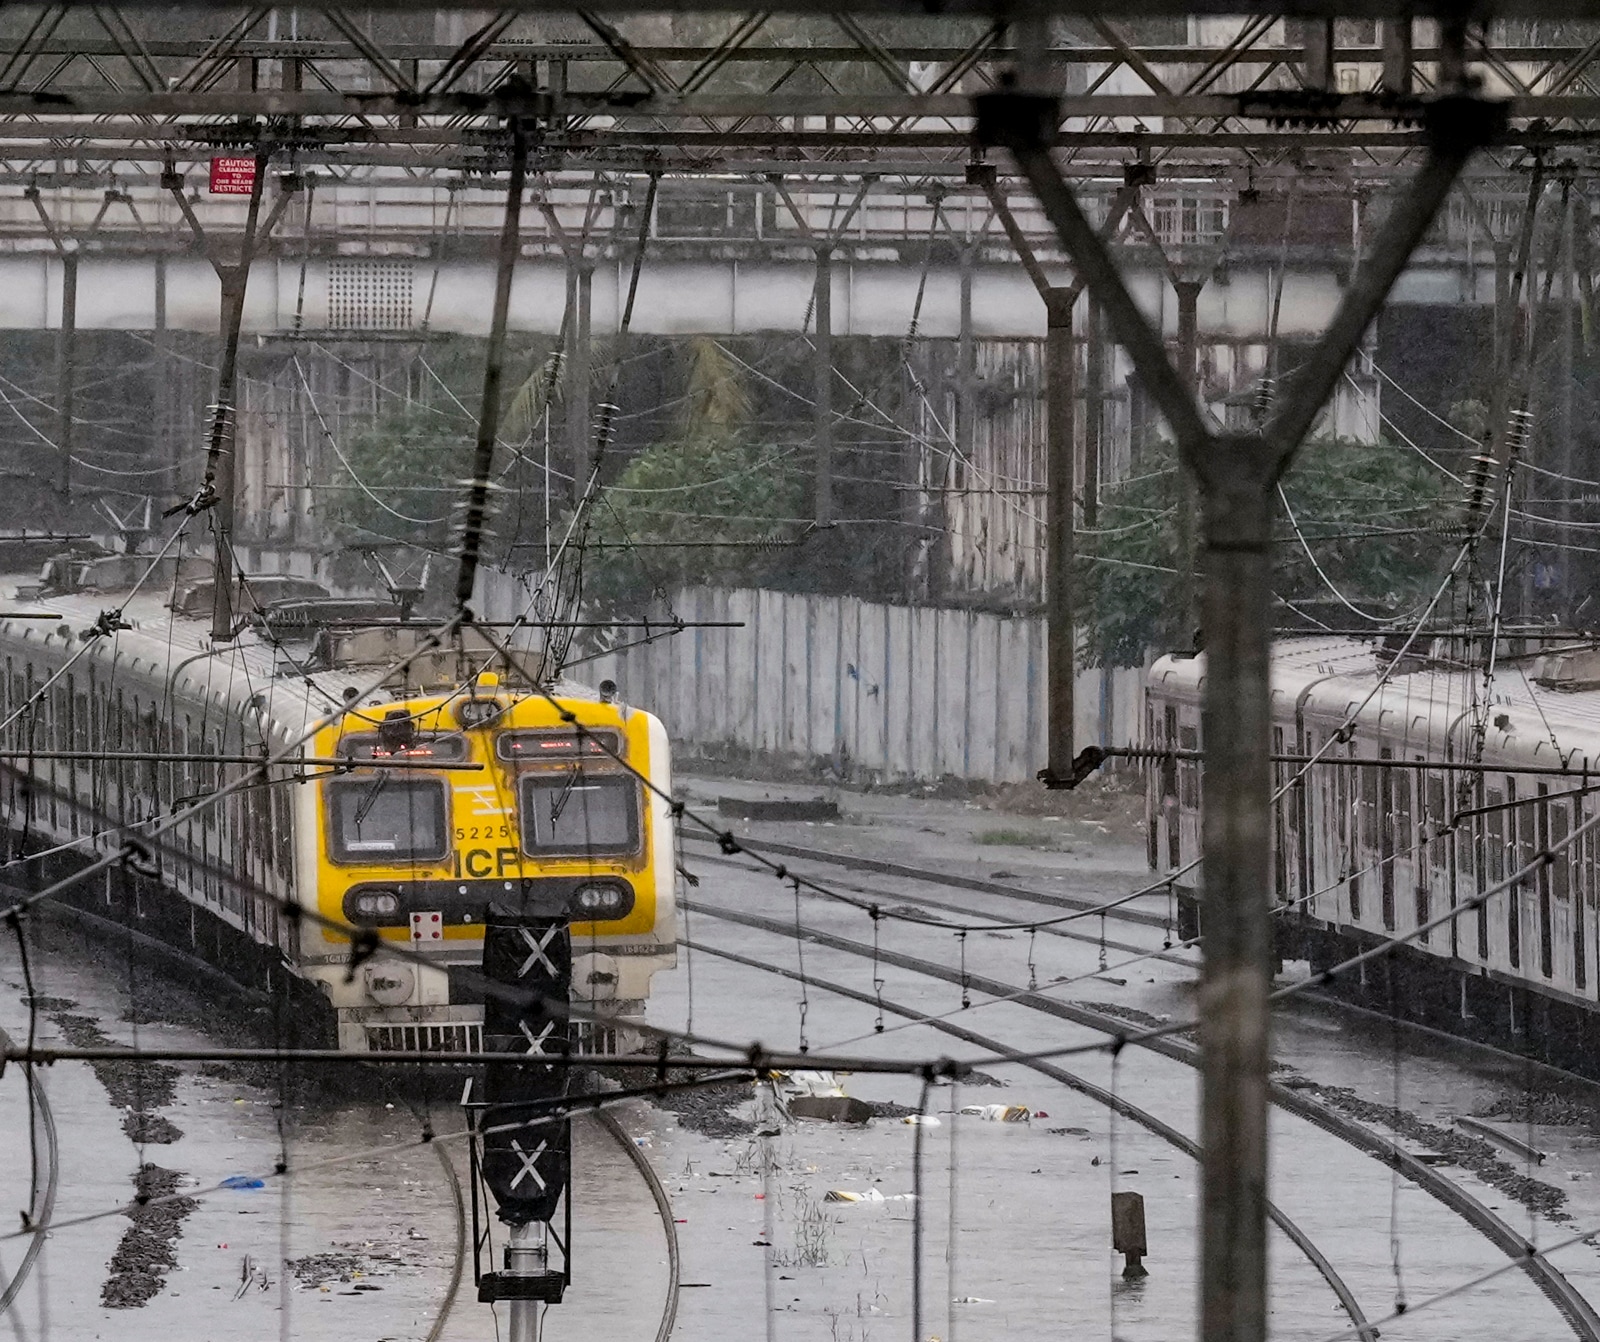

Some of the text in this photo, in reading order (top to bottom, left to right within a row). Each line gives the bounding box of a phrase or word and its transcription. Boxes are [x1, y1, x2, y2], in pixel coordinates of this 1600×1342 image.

[219, 159, 256, 167] CAUTION
[456, 826, 509, 840] 5225
[453, 847, 519, 878] ICF
